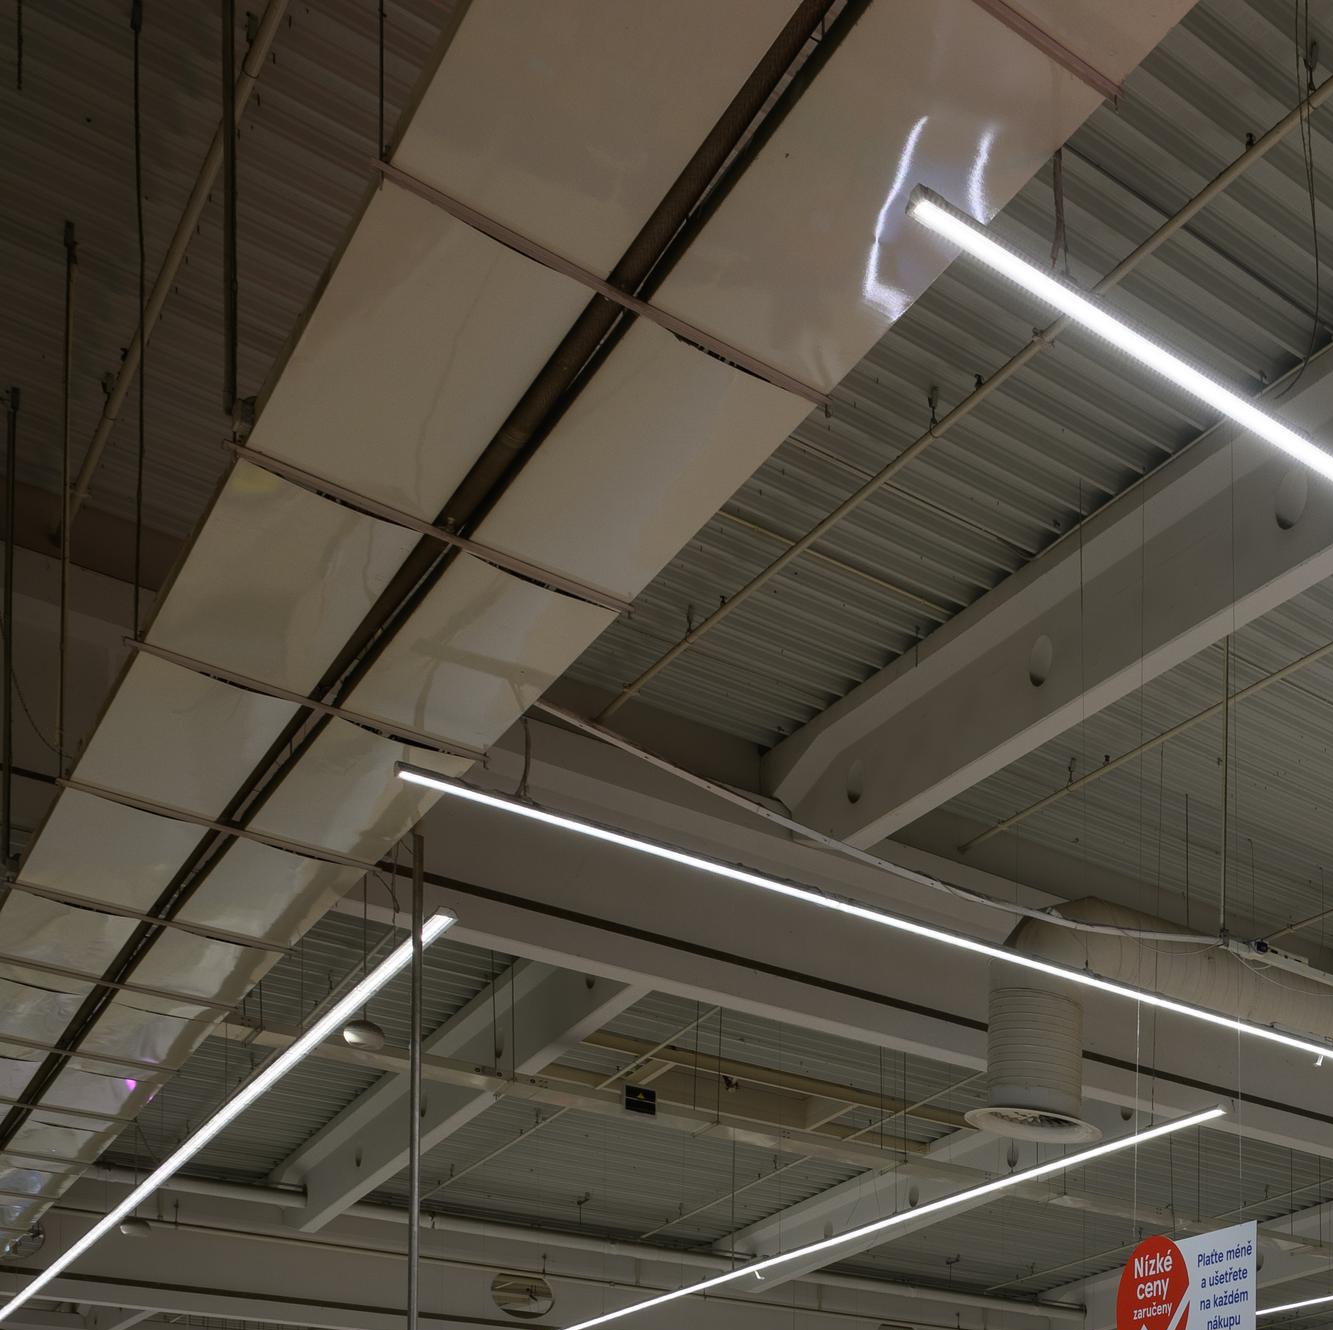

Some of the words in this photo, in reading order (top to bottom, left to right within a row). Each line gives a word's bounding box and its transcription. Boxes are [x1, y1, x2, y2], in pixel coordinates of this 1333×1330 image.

[1134, 1247, 1173, 1280] Nízké
[1197, 1248, 1227, 1269] Plaťte
[1229, 1241, 1253, 1262] méně
[1136, 1275, 1170, 1302] ceny
[1201, 1278, 1207, 1289] a
[1208, 1266, 1248, 1288] ušetřete
[1133, 1301, 1172, 1322] zaručeny
[1200, 1299, 1211, 1312] na
[1213, 1287, 1249, 1309] každém
